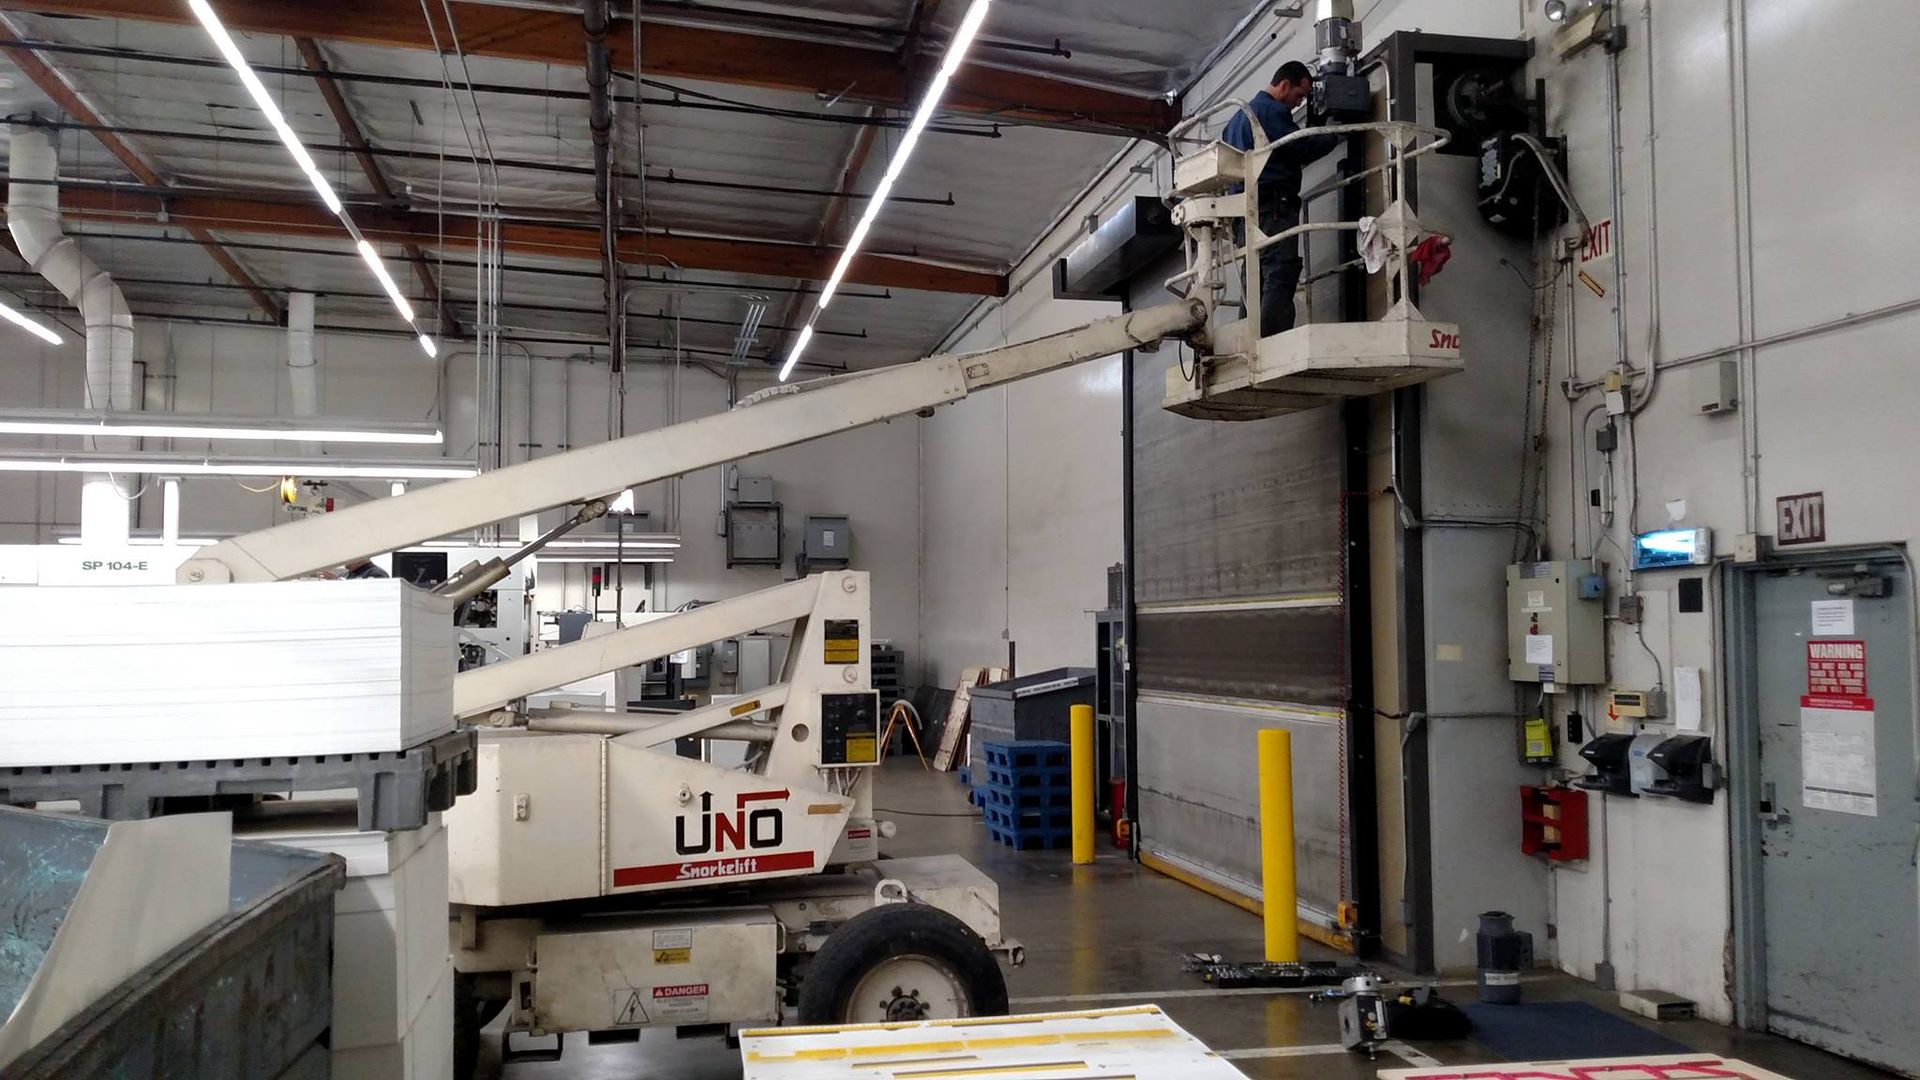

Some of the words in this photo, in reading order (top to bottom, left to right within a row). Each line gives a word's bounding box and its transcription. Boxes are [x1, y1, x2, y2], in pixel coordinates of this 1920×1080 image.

[1778, 496, 1823, 540] EXIT
[82, 560, 103, 571] SP
[106, 560, 149, 571] 104-E
[1808, 643, 1864, 659] WARNING
[675, 803, 783, 856] UNO
[675, 858, 758, 881] Snorkelift
[664, 985, 707, 997] DANGER
